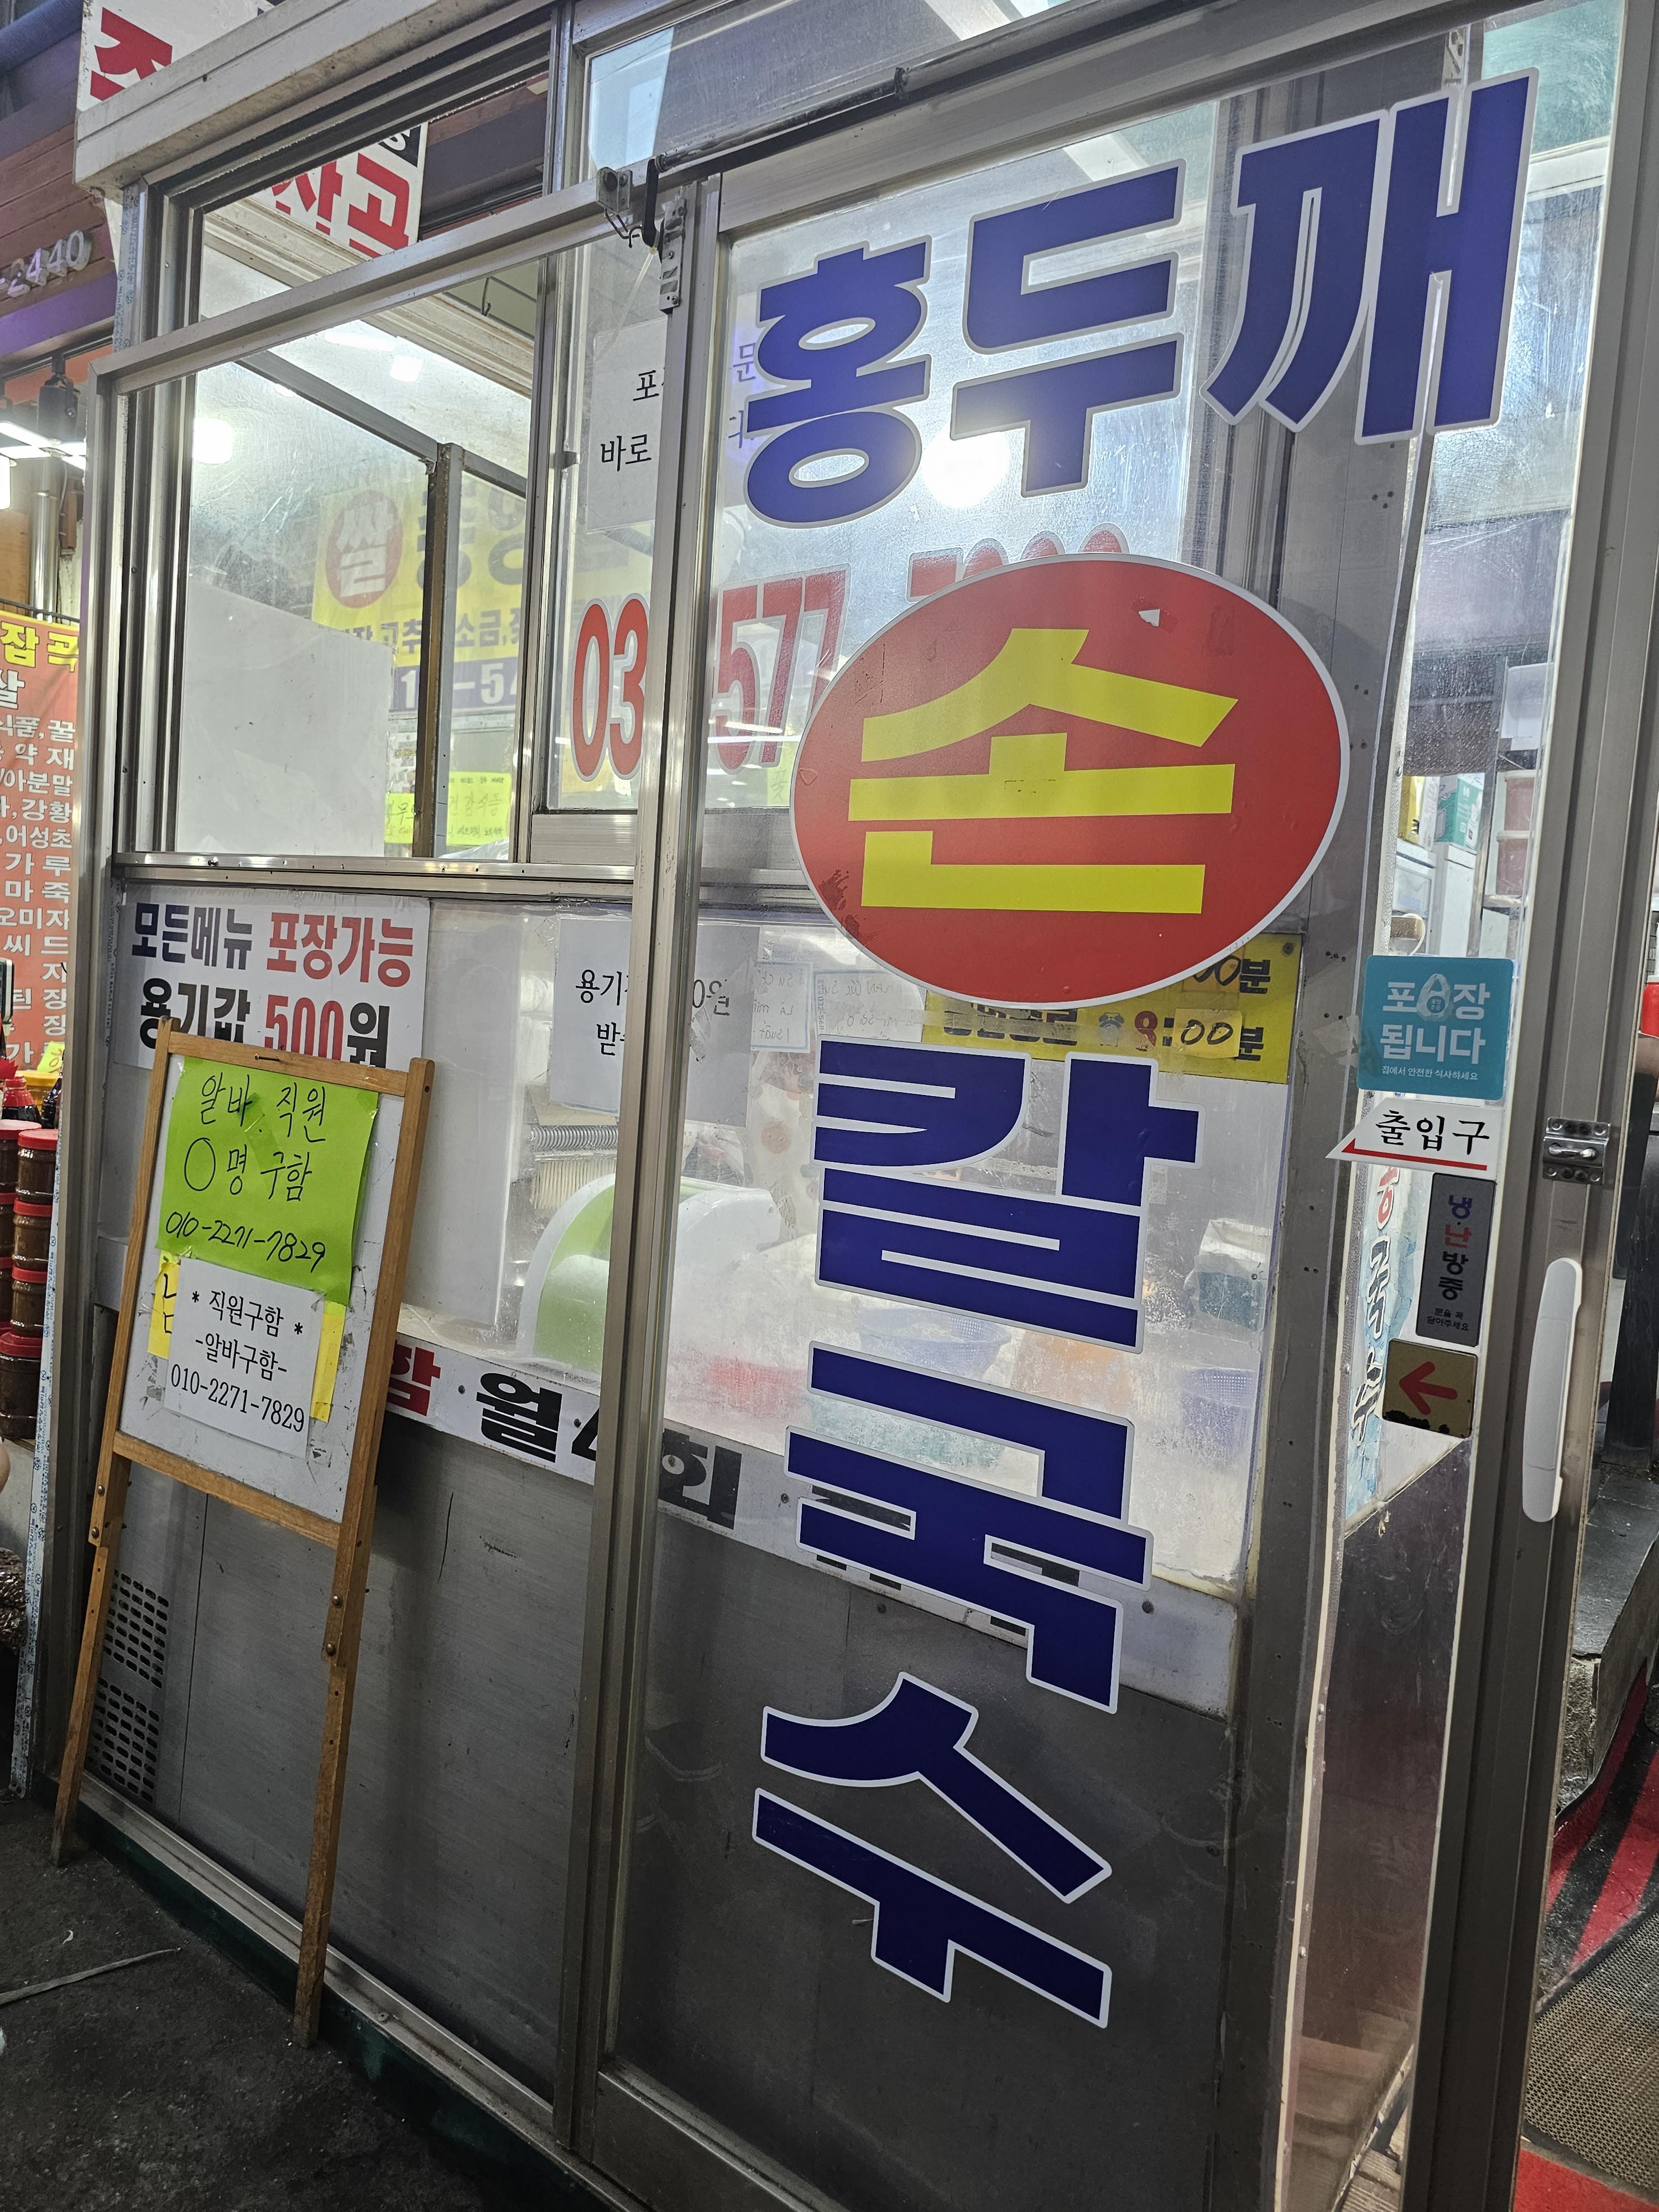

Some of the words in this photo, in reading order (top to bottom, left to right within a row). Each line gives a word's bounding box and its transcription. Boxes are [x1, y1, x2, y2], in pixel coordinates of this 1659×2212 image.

[747, 77, 1530, 523] 홍두깨
[632, 367, 664, 401] 포
[599, 433, 652, 472] 바로
[573, 598, 649, 775] 03
[848, 628, 1239, 914] 손
[132, 902, 253, 971] 모든메뉴
[267, 912, 413, 988] 포장가능
[575, 969, 629, 1006] 용기
[1383, 981, 1490, 1021] 포장
[264, 994, 390, 1069] 500원
[596, 1021, 627, 1057] 받
[1380, 1024, 1486, 1065] 됩니다
[1407, 1067, 1433, 1078] 안전한
[276, 1082, 326, 1143] 직원
[1375, 1109, 1490, 1155] 출입구
[260, 1151, 312, 1201] 구함
[165, 1211, 326, 1273] 010-2271-7829
[209, 1290, 284, 1338] 직원구함
[170, 1364, 305, 1432] 010-2271-7829
[756, 1041, 1199, 2022] 칼국수
